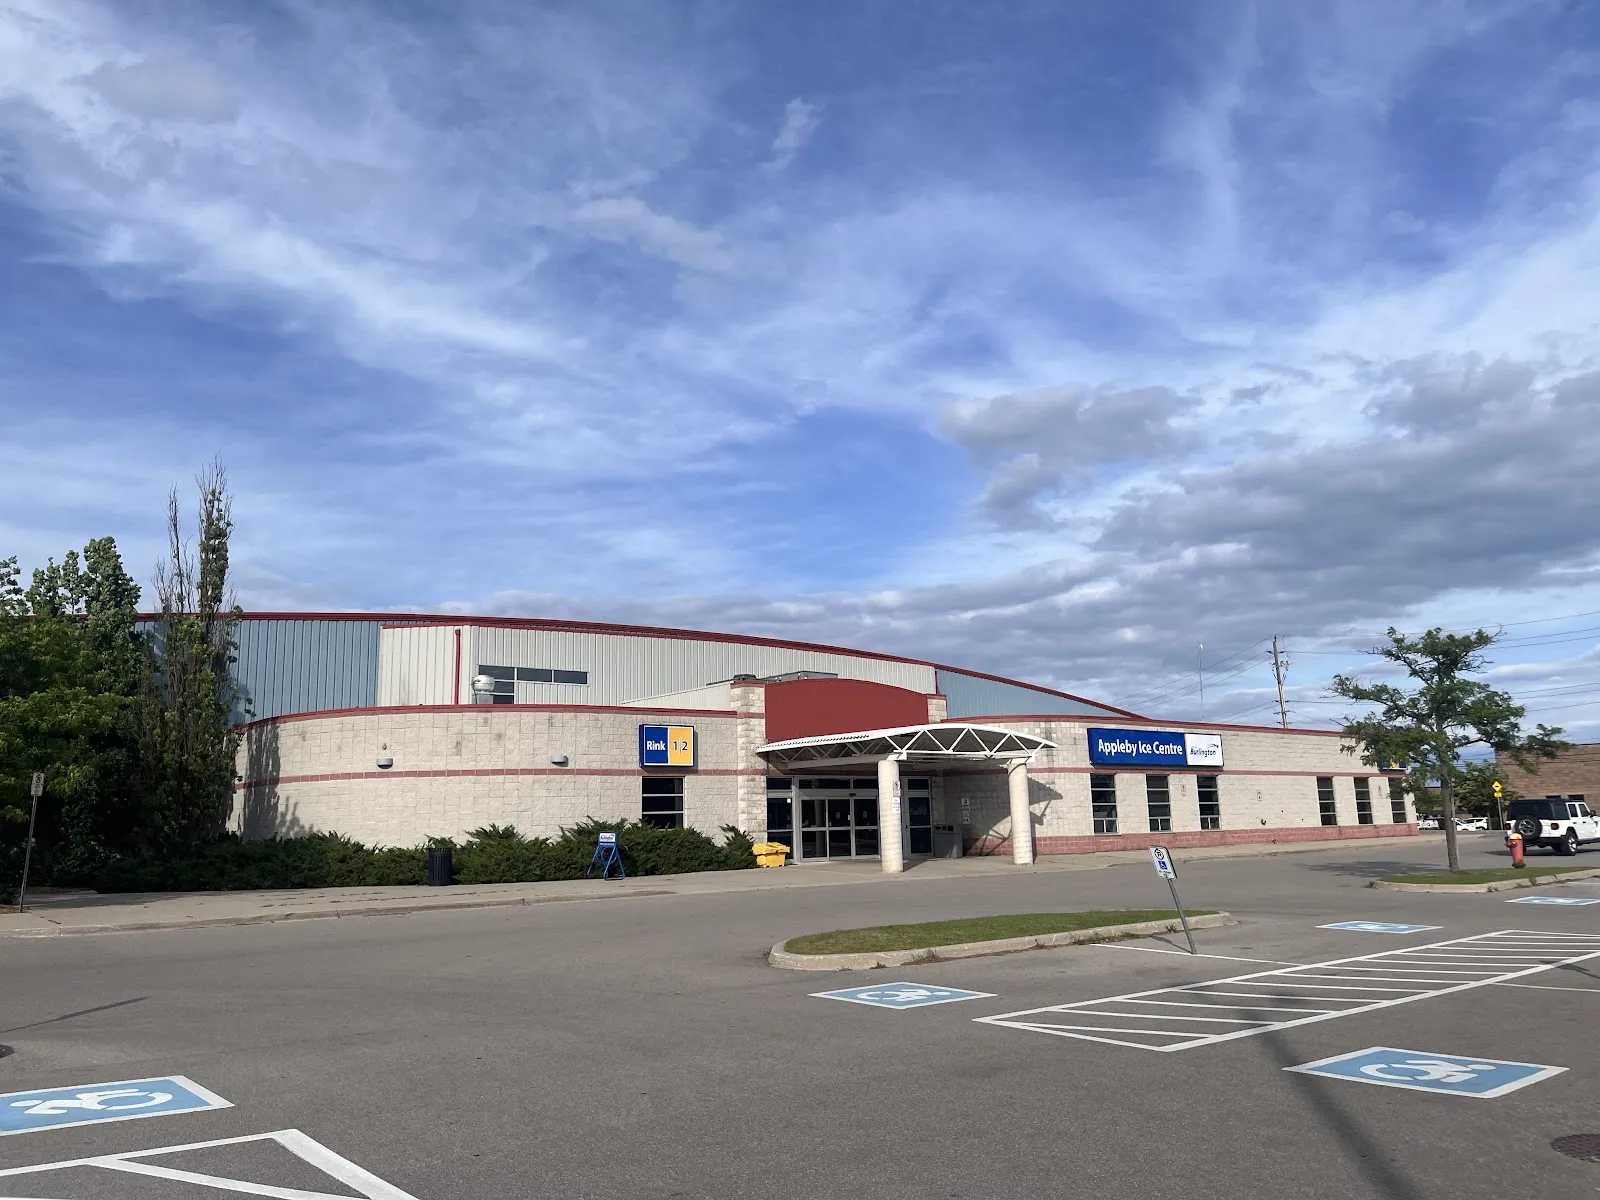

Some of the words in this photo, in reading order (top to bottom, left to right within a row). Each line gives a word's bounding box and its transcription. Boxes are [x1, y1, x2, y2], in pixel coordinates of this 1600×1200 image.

[646, 740, 666, 751] Rink
[1098, 738, 1137, 757] Appleby
[1138, 740, 1152, 754] Ice
[1153, 741, 1183, 755] Centre
[1190, 746, 1217, 758] Burlington
